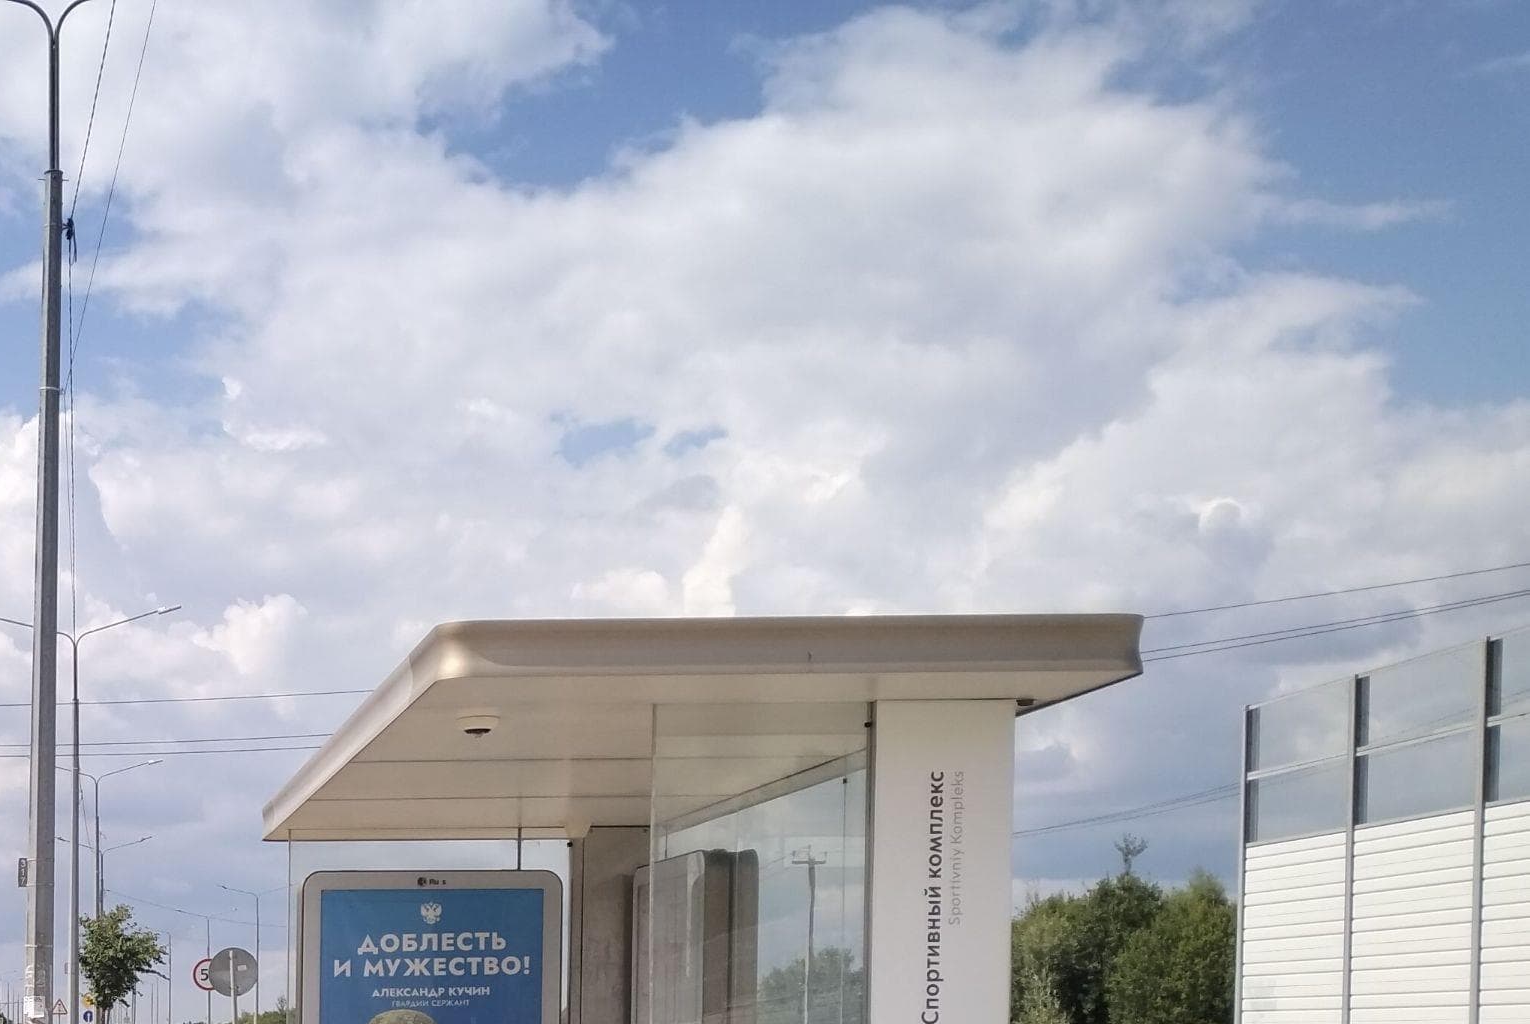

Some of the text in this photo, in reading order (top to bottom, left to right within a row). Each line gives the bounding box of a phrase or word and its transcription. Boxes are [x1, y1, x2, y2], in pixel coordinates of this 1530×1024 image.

[949, 770, 965, 925] Sportivniy Kompleks
[921, 771, 945, 1024] Спортивный комплекс
[357, 931, 507, 956] ДОБЛЕСТЬ
[333, 956, 531, 978] И МУЖЕСТВО!
[372, 986, 491, 998] АЛЕКСАНДР КУЧИН
[431, 999, 470, 1007] СЕРЖАНТ
